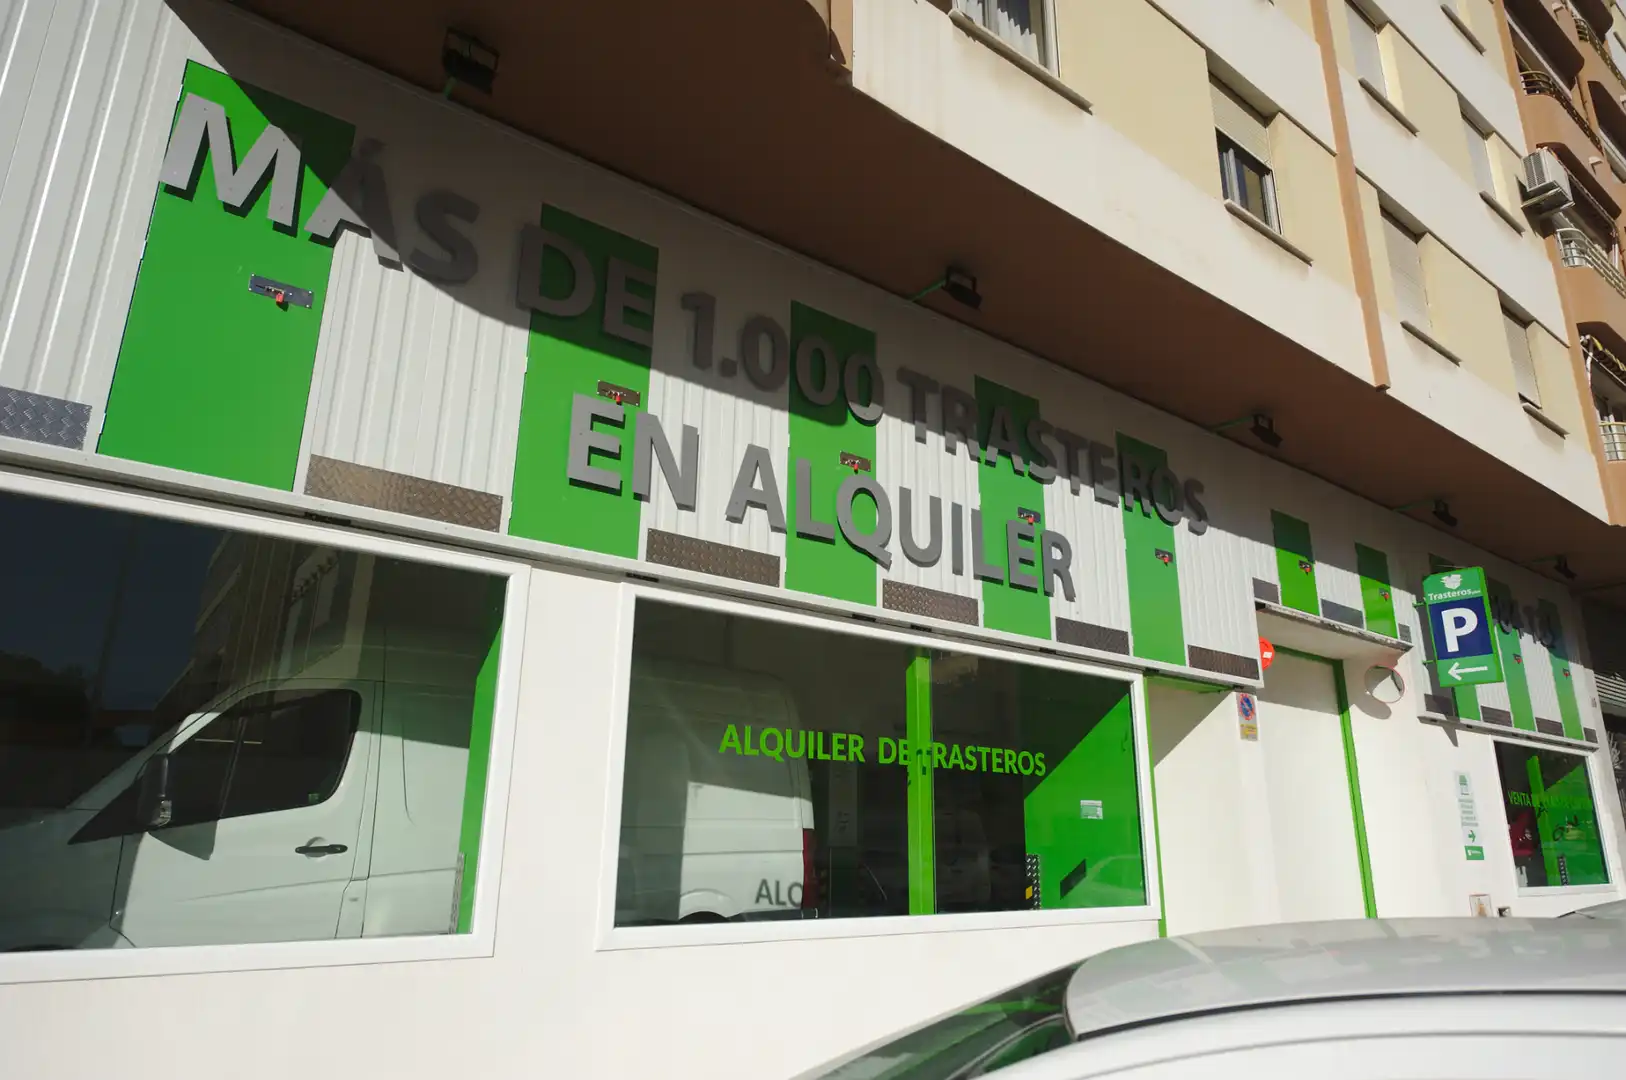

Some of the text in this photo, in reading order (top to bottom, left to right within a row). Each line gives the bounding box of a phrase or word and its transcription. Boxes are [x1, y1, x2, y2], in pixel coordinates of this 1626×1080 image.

[160, 92, 1208, 536] MÁS DE 1.000 TRASTEROS
[566, 393, 1075, 601] EN ALQUILER
[1427, 588, 1472, 601] Trasteros
[1441, 607, 1478, 653] P
[718, 723, 866, 762] ALQUILER
[878, 737, 914, 766] DE
